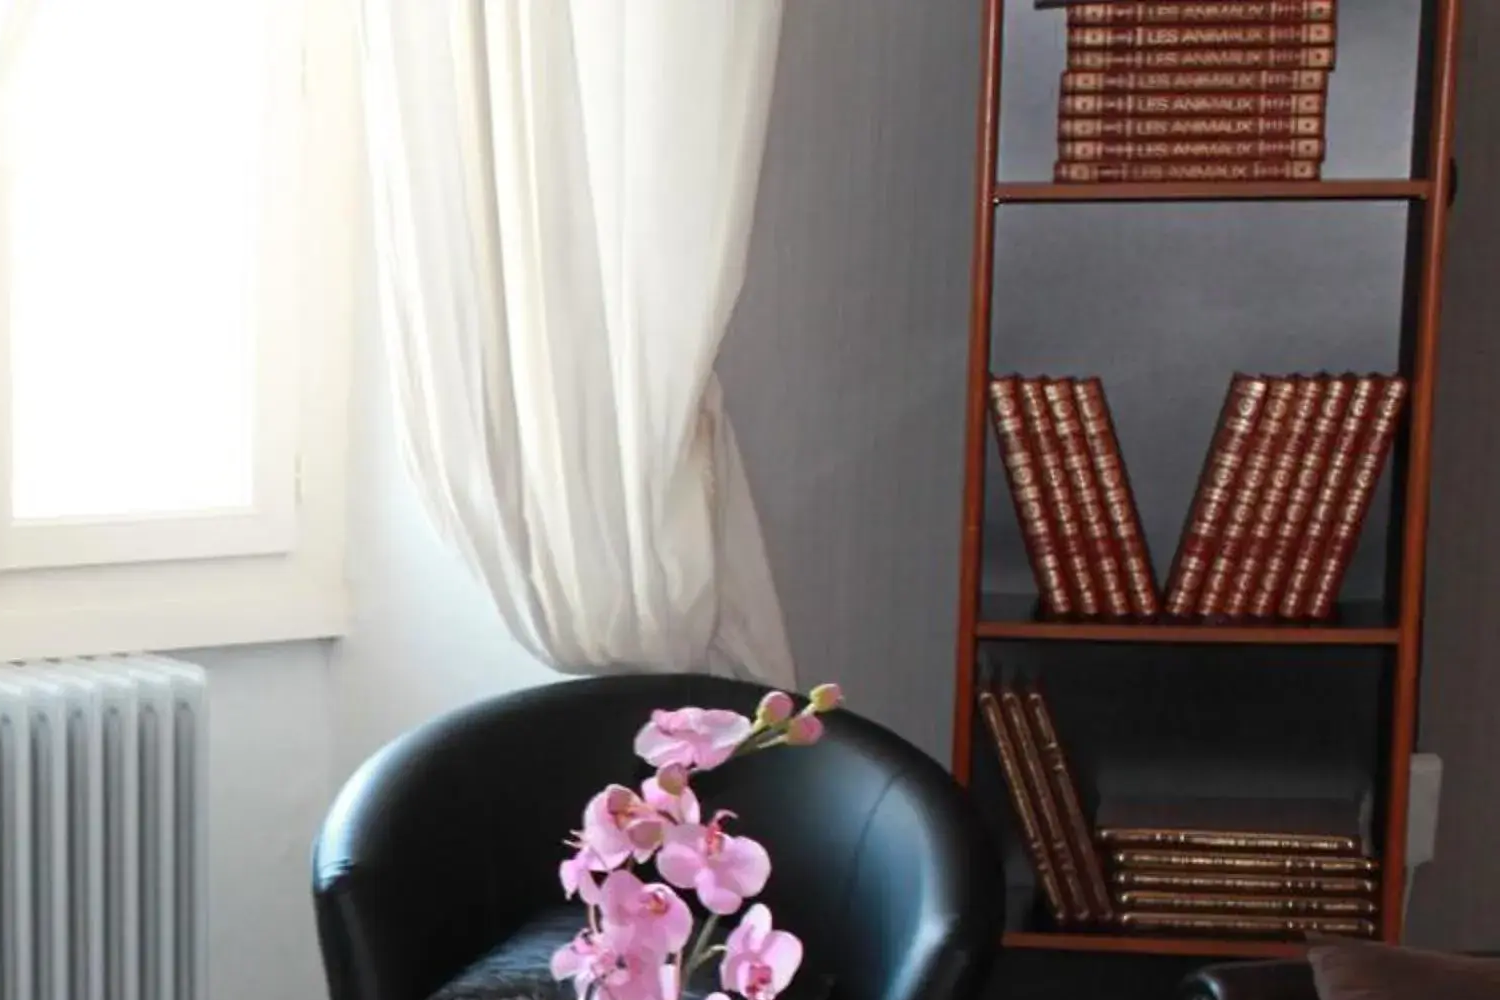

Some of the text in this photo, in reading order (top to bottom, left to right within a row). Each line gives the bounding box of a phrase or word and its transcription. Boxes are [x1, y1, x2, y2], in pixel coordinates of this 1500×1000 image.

[1147, 5, 1179, 18] LES
[1147, 29, 1178, 44] LES
[1181, 28, 1261, 43] ANIMAUX
[1146, 52, 1177, 65] LES
[1138, 73, 1171, 88] LES
[1174, 72, 1253, 88] ANIMAUX
[1138, 97, 1169, 112] LES
[1172, 96, 1252, 111] ANIMAUX
[1137, 120, 1168, 135] LES
[1171, 120, 1252, 134] ANIMAUX
[1137, 143, 1168, 157] LES
